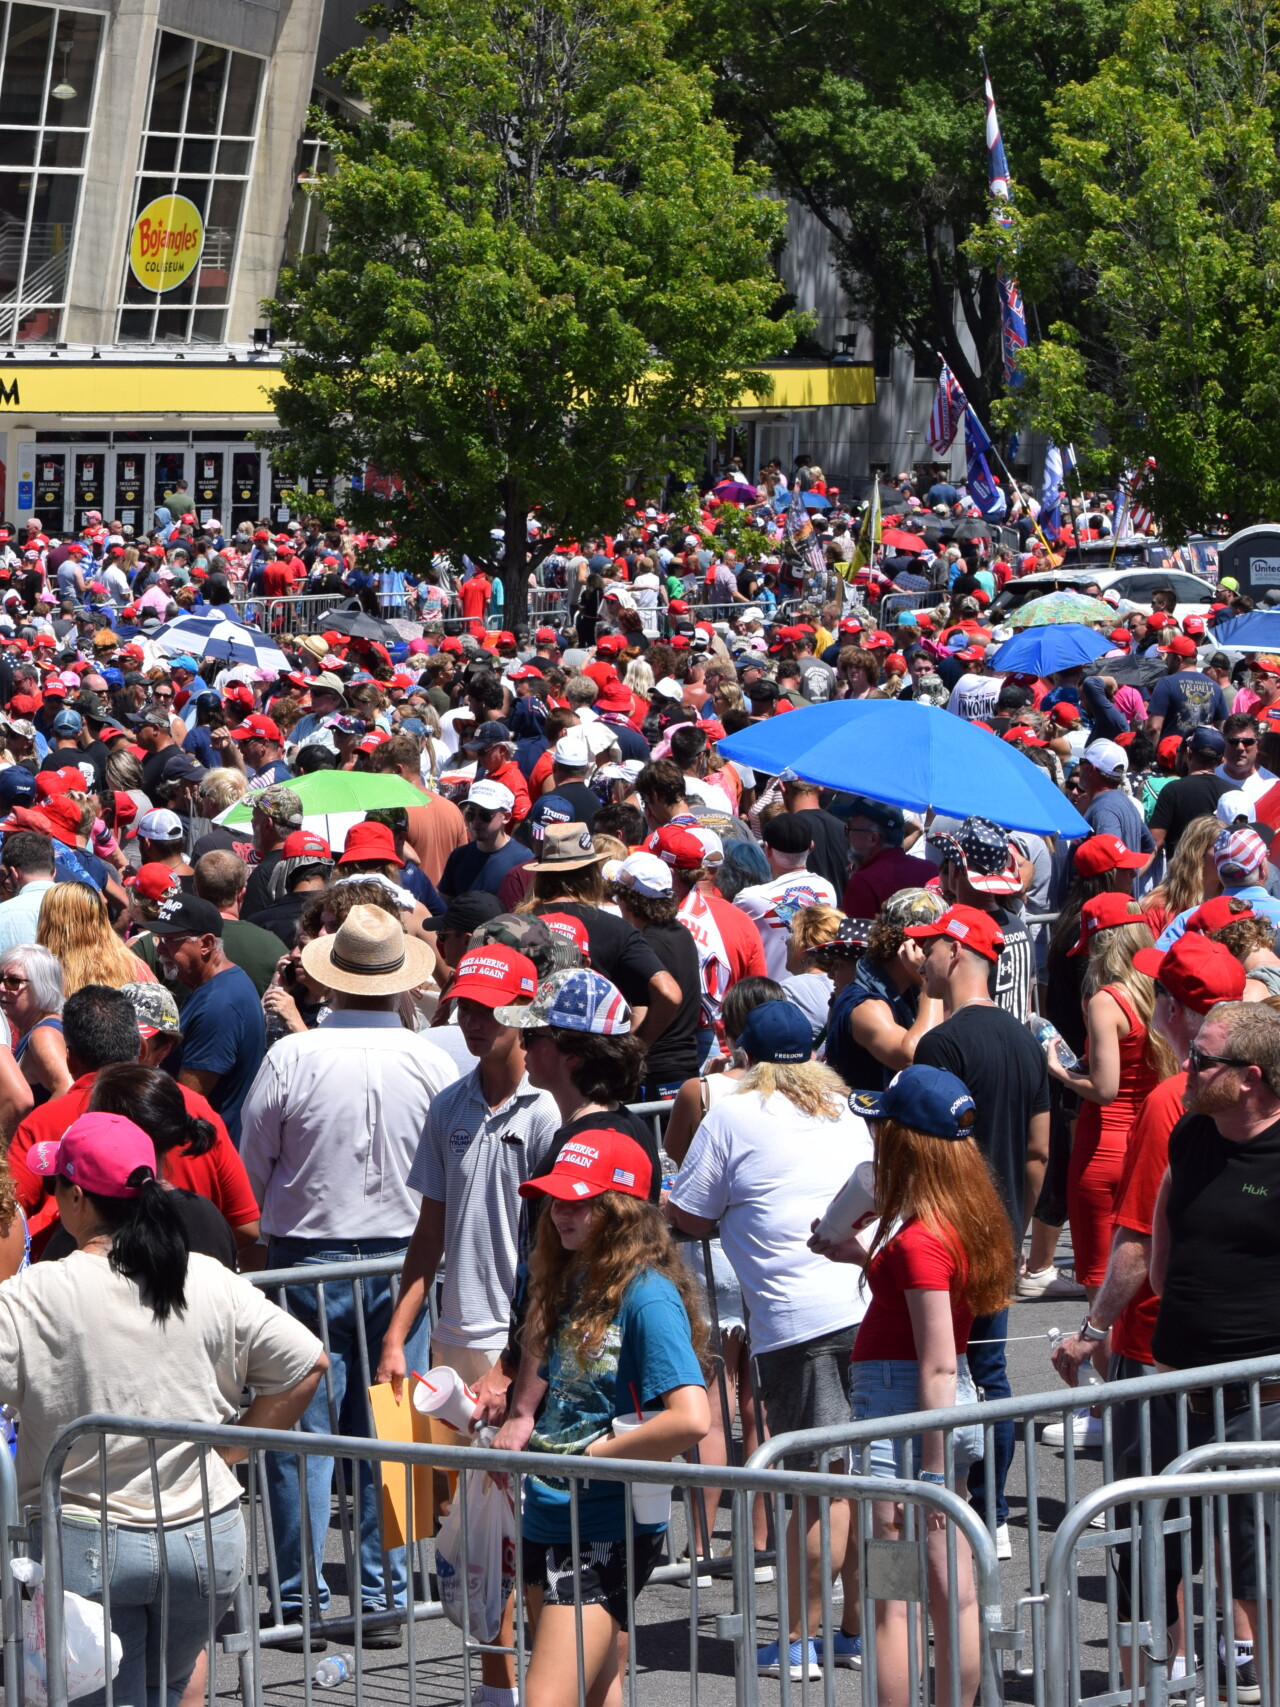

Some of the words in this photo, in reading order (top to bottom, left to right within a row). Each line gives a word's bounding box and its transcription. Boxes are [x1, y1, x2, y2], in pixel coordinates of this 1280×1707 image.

[138, 217, 199, 258] Bojangles
[144, 261, 186, 273] COLISEUM
[1179, 684, 1215, 695] VALHALLA
[543, 807, 570, 822] Trump
[475, 957, 509, 972] AMERICA
[478, 967, 504, 980] AGAIN
[853, 1104, 880, 1115] PRESIDENT
[950, 1095, 969, 1115] DONALD
[565, 1153, 593, 1168] AGAIN
[1242, 1183, 1269, 1196] Huk
